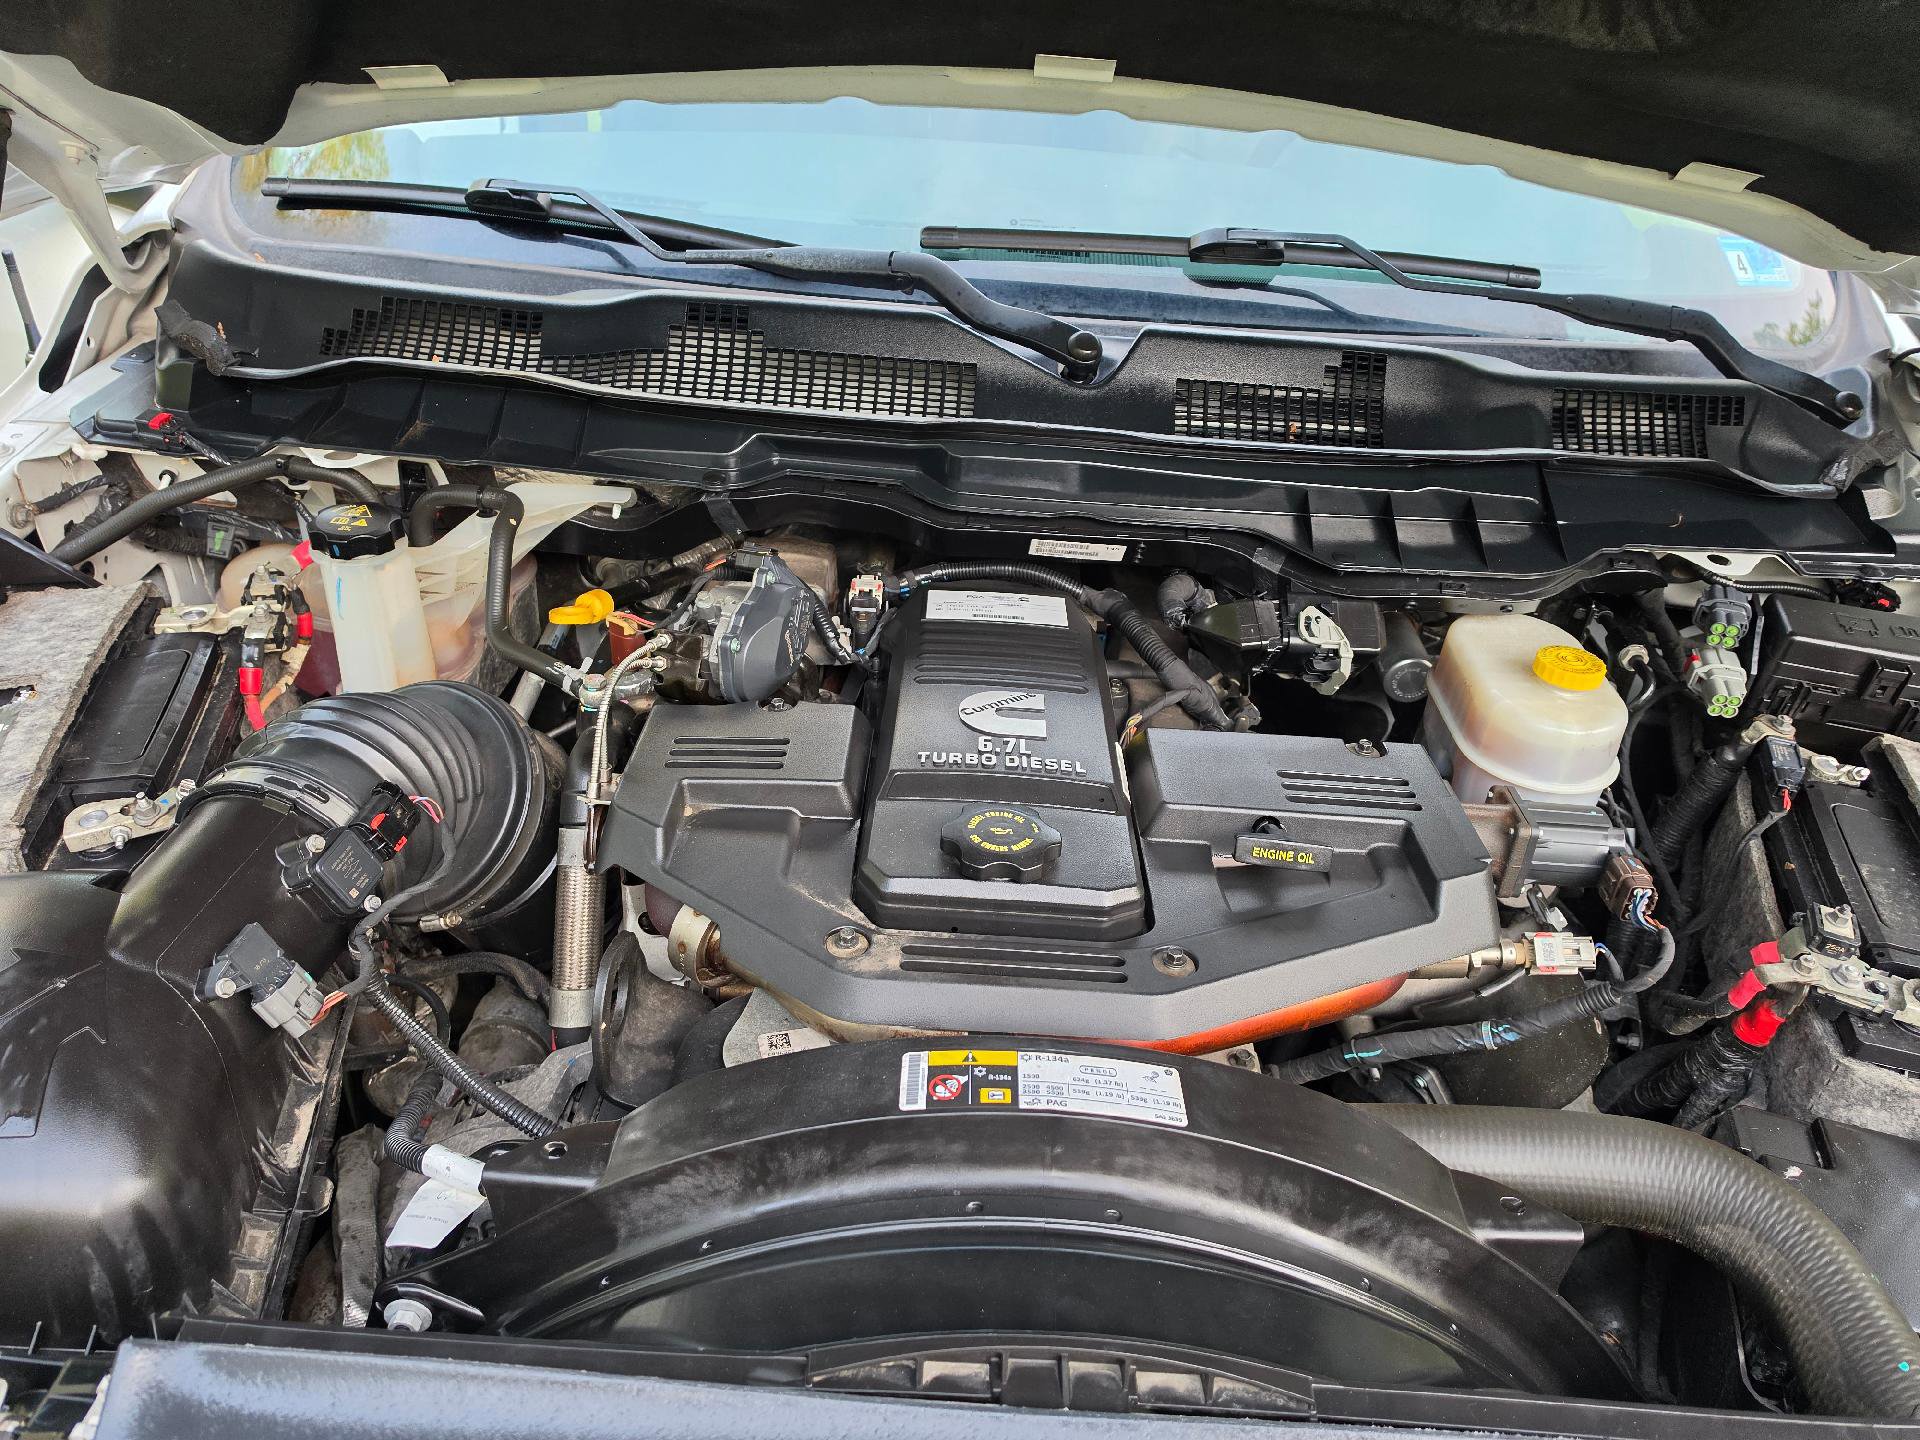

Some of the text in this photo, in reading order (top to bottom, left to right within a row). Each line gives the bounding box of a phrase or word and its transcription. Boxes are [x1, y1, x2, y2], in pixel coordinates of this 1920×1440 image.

[1737, 254, 1748, 275] 4
[978, 736, 1032, 755] 6.7L
[917, 751, 1087, 775] TURBO DIESEL
[1252, 846, 1315, 864] ENGINE OIL
[1035, 1054, 1070, 1064] R-134a
[1046, 1099, 1068, 1107] PAG
